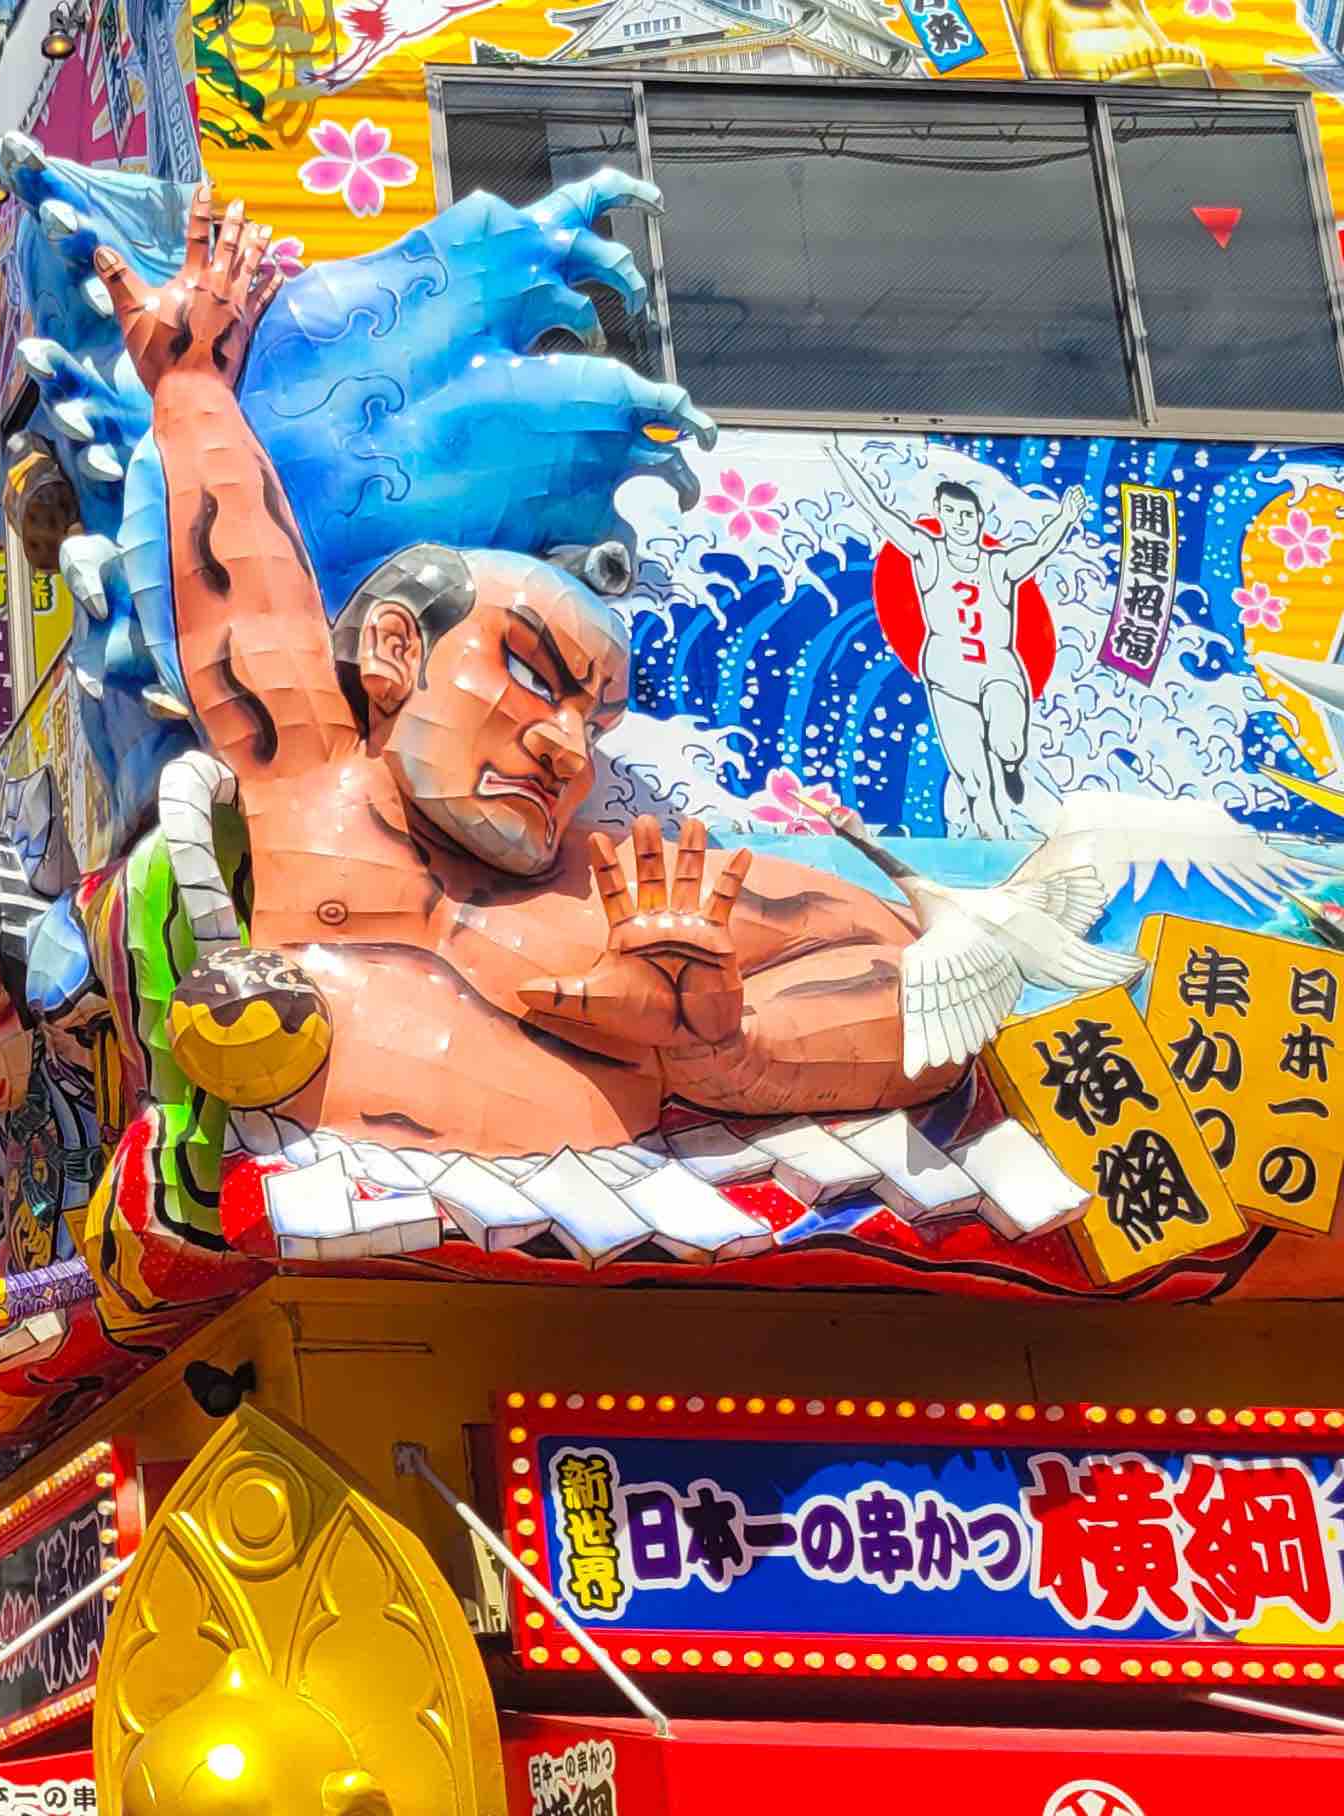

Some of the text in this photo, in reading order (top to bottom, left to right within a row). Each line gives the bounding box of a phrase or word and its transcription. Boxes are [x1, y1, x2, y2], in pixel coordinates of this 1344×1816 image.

[913, 0, 971, 53] 来
[951, 579, 988, 665] グリコ
[1113, 493, 1171, 666] 開運招福
[1033, 1018, 1210, 1253] 横綱
[1167, 945, 1252, 1171] 串かつ
[1257, 965, 1338, 1204] 日本一の
[558, 1453, 626, 1612] 新世界
[624, 1489, 1022, 1585] 日本一の串かつ
[1028, 1459, 1332, 1624] 横綱
[531, 1746, 612, 1790] 日本一の串かつ
